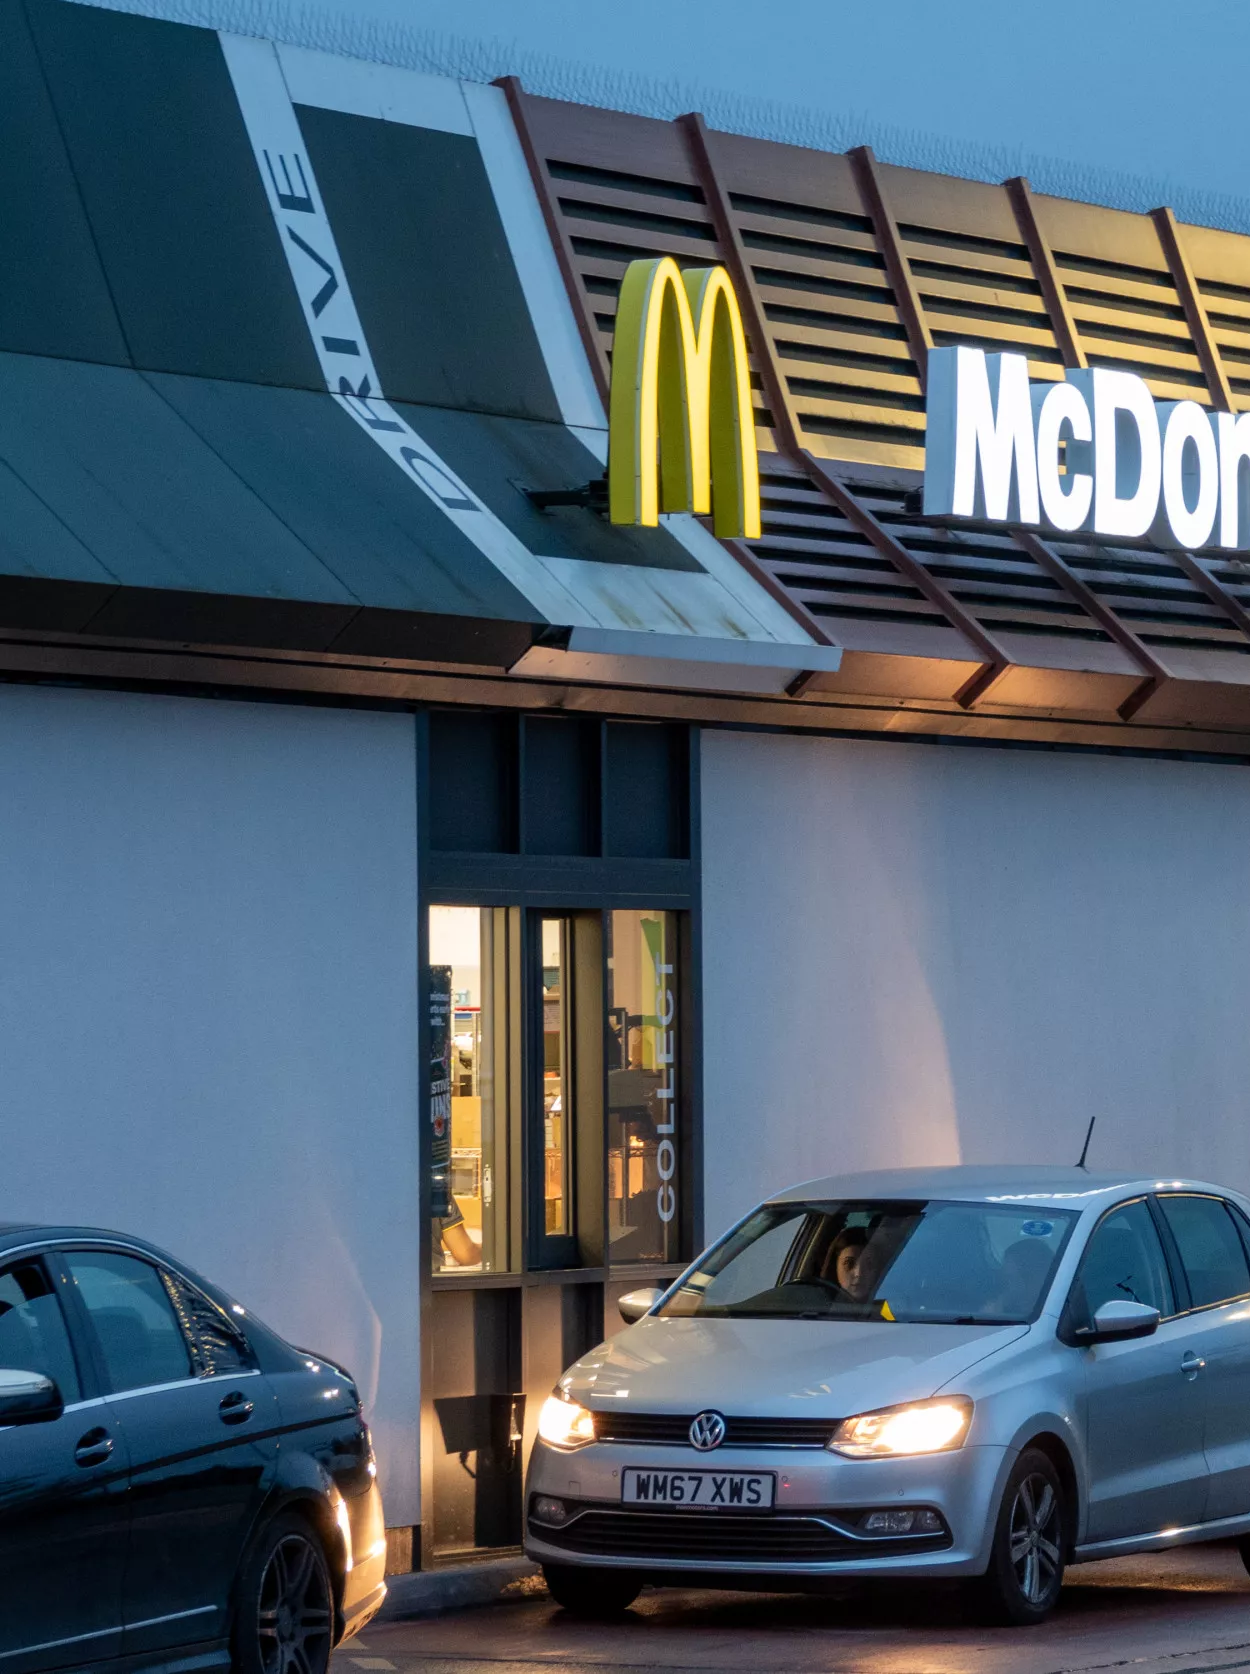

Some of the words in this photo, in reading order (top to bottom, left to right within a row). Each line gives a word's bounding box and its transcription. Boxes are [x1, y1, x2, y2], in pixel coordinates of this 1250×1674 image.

[263, 148, 483, 513] DRIVE
[655, 951, 676, 1223] COLLECT
[636, 1474, 703, 1502] WM67
[710, 1476, 762, 1504] XWS
